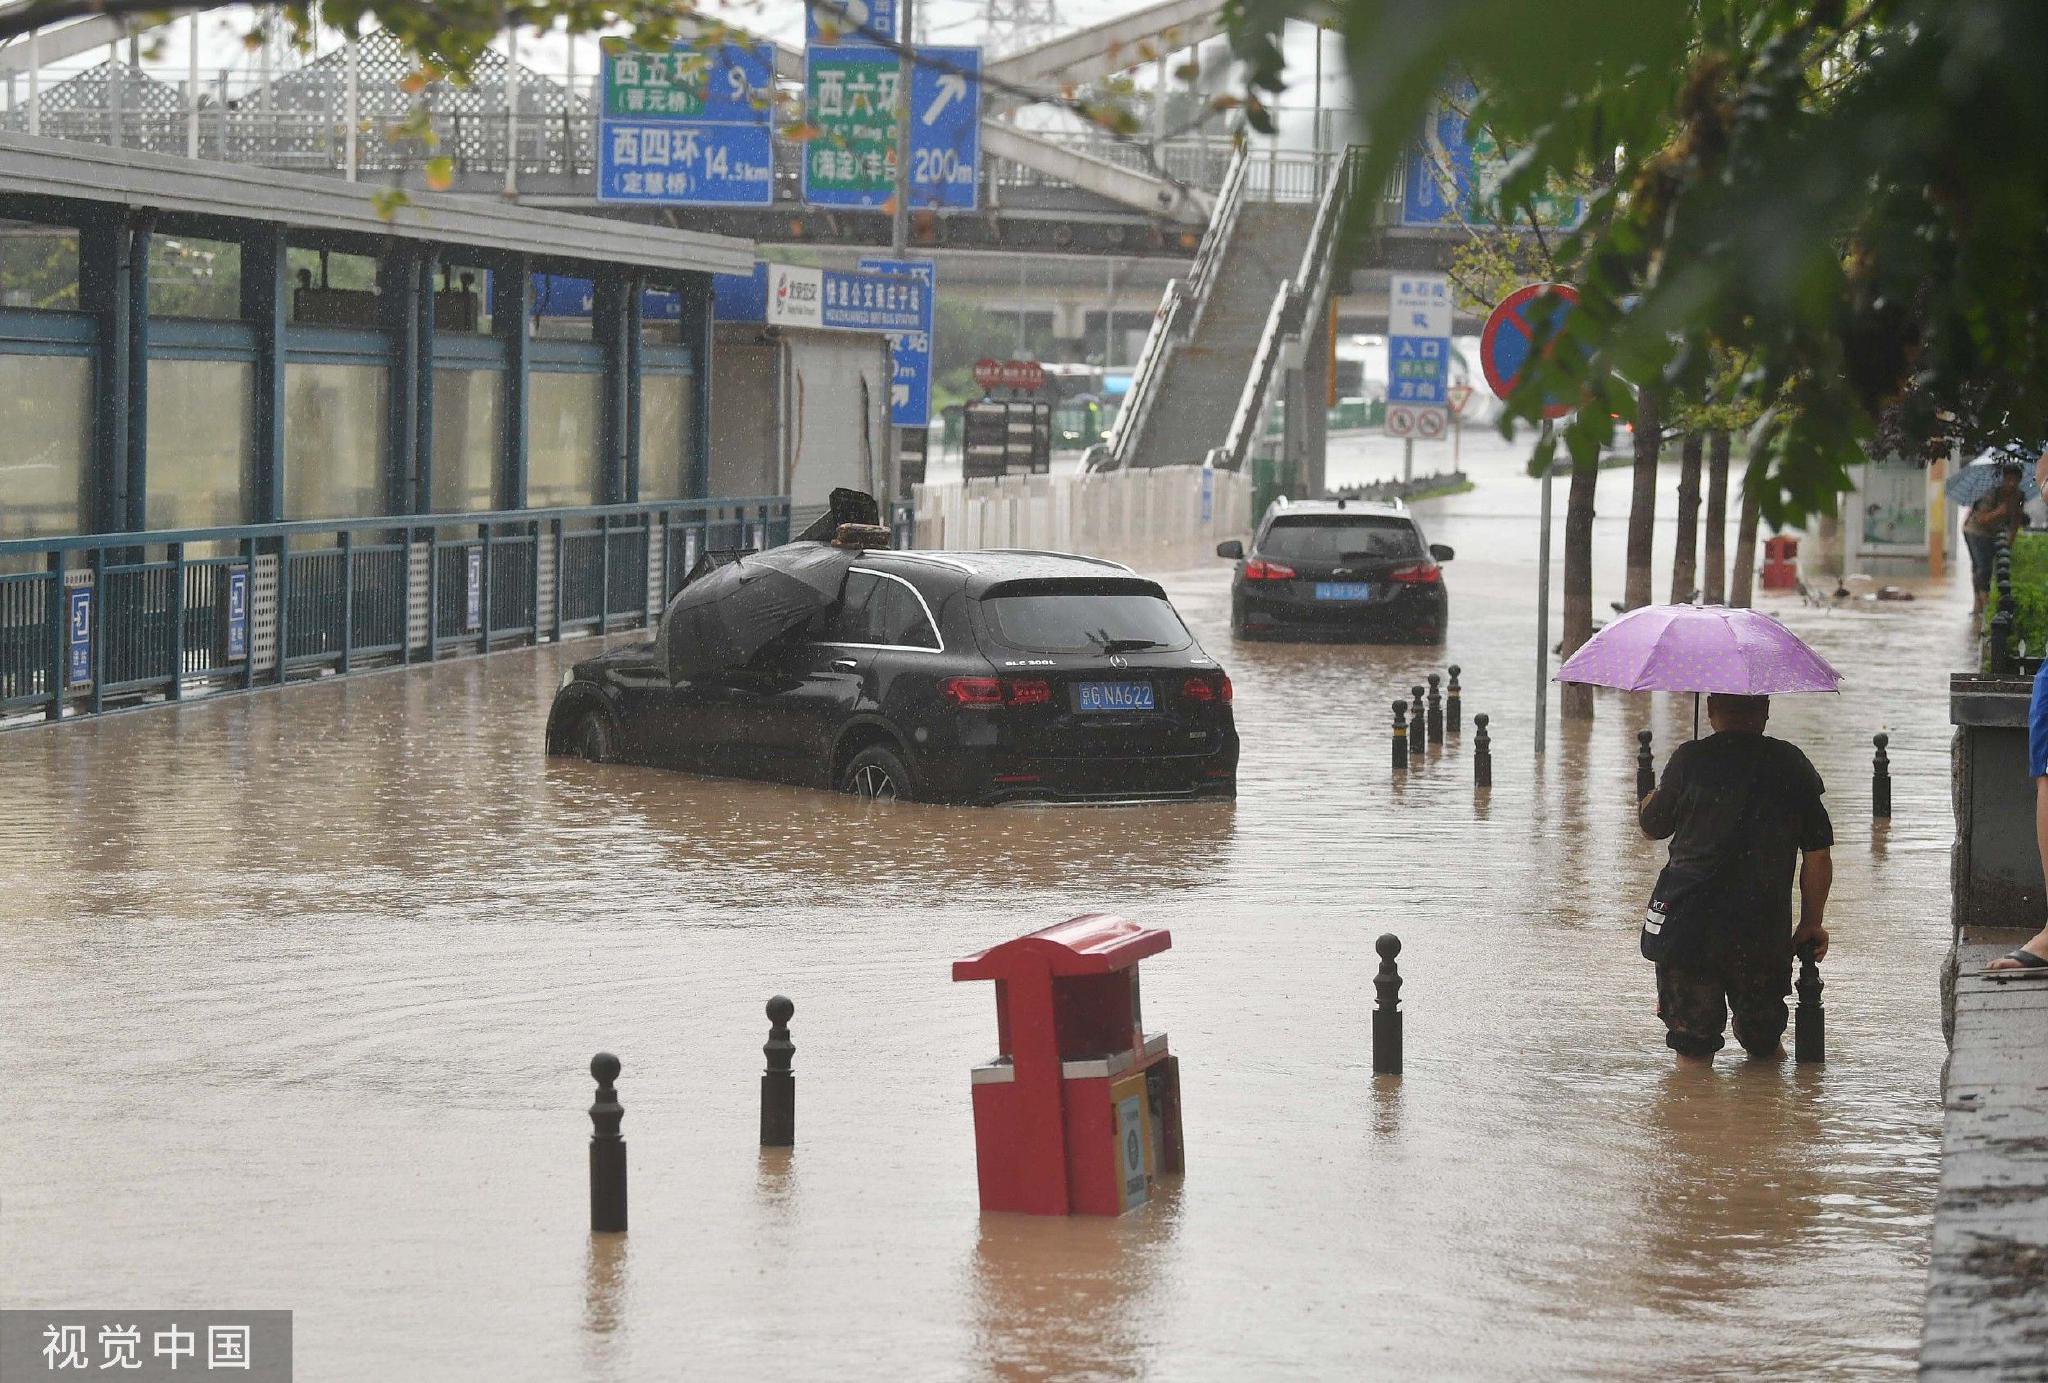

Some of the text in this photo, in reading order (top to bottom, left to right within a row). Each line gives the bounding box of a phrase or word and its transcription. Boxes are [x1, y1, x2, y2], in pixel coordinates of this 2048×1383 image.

[614, 52, 702, 87] 西五环
[817, 70, 899, 118] 西六环
[612, 128, 700, 167] 西四环
[915, 148, 973, 183] 200m
